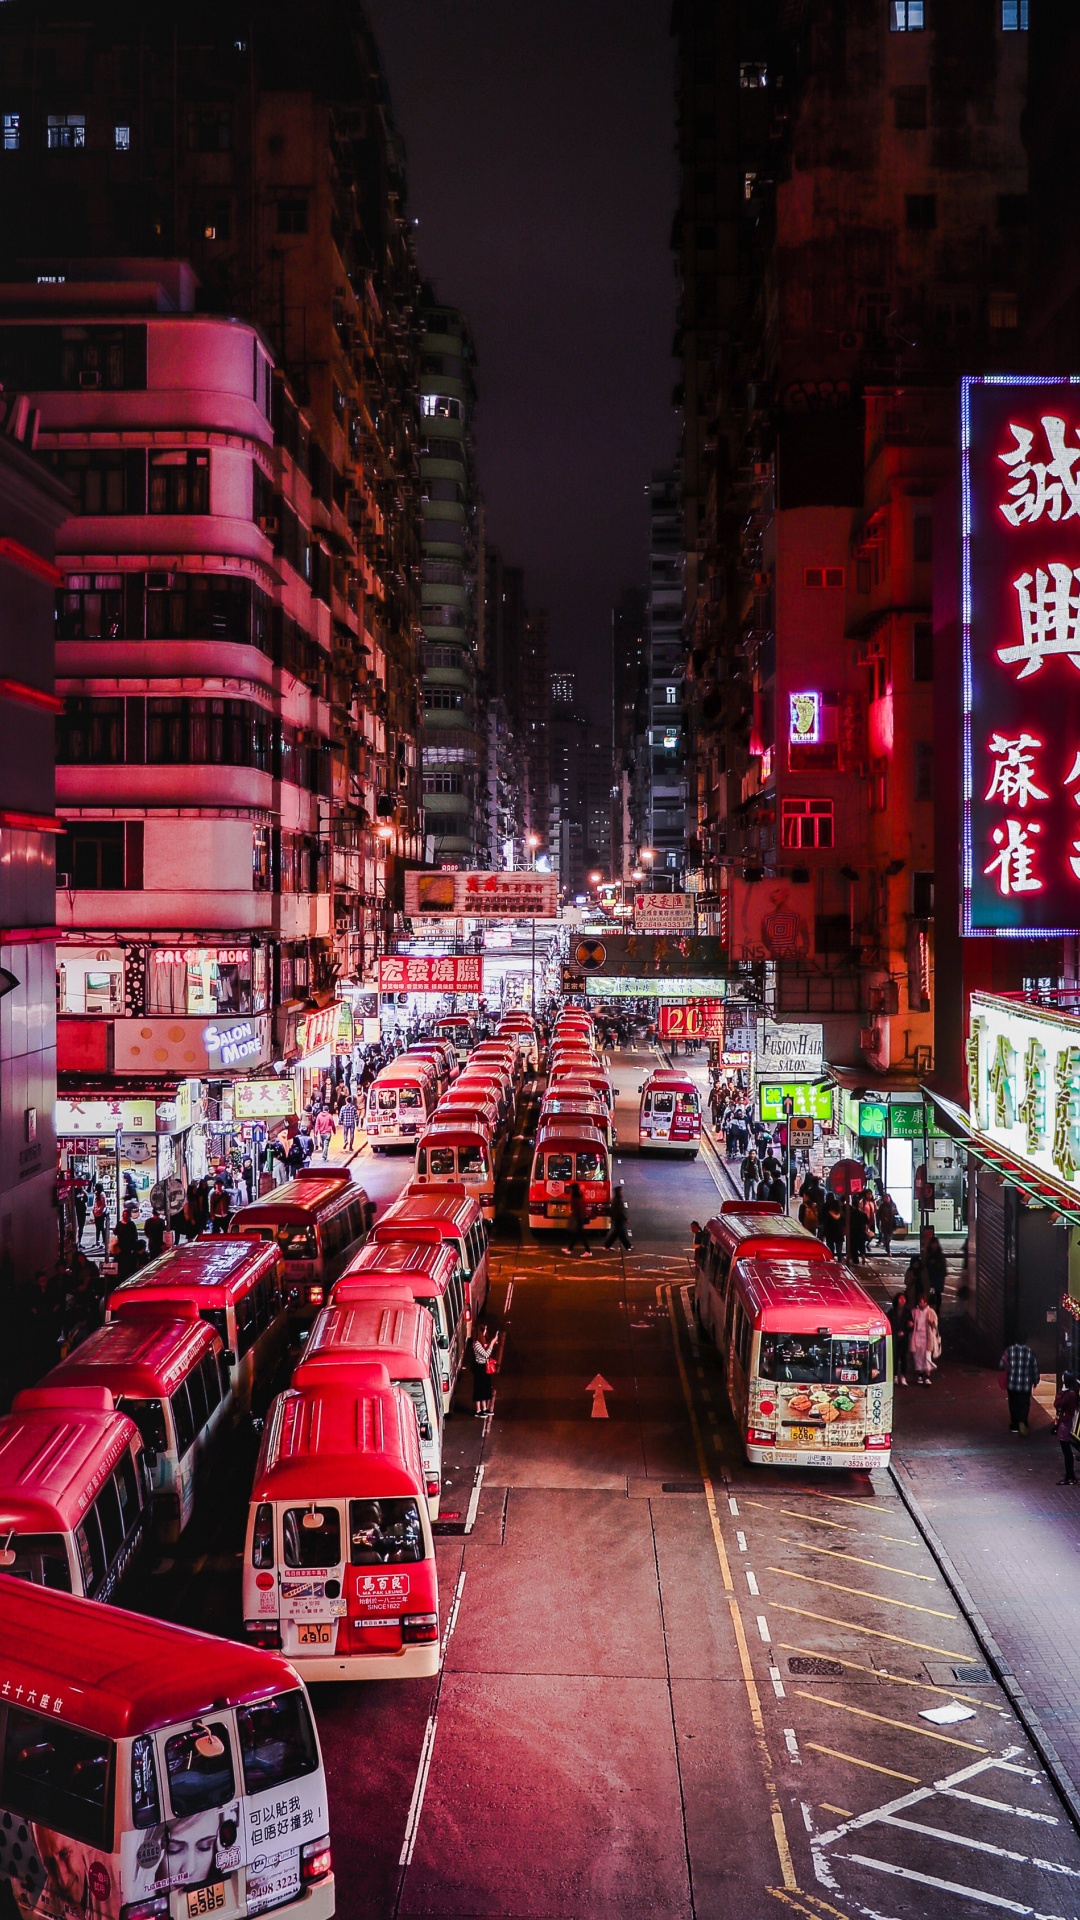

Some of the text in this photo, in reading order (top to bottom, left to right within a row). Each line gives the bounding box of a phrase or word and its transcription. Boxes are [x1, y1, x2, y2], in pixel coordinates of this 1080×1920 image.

[218, 950, 249, 963] MORE
[381, 958, 480, 982] 宏發燒臘
[205, 1022, 252, 1052] SALON
[222, 1037, 262, 1064] MORE
[778, 1059, 808, 1072] SALON
[237, 1083, 293, 1103] 海天堂
[794, 1137, 809, 1145] 全日
[362, 1576, 403, 1591] 馬百良
[249, 1795, 301, 1826] 可以貼我
[275, 1872, 298, 1891] 3223
[197, 1885, 215, 1900] EN
[190, 1894, 224, 1916] 5385
